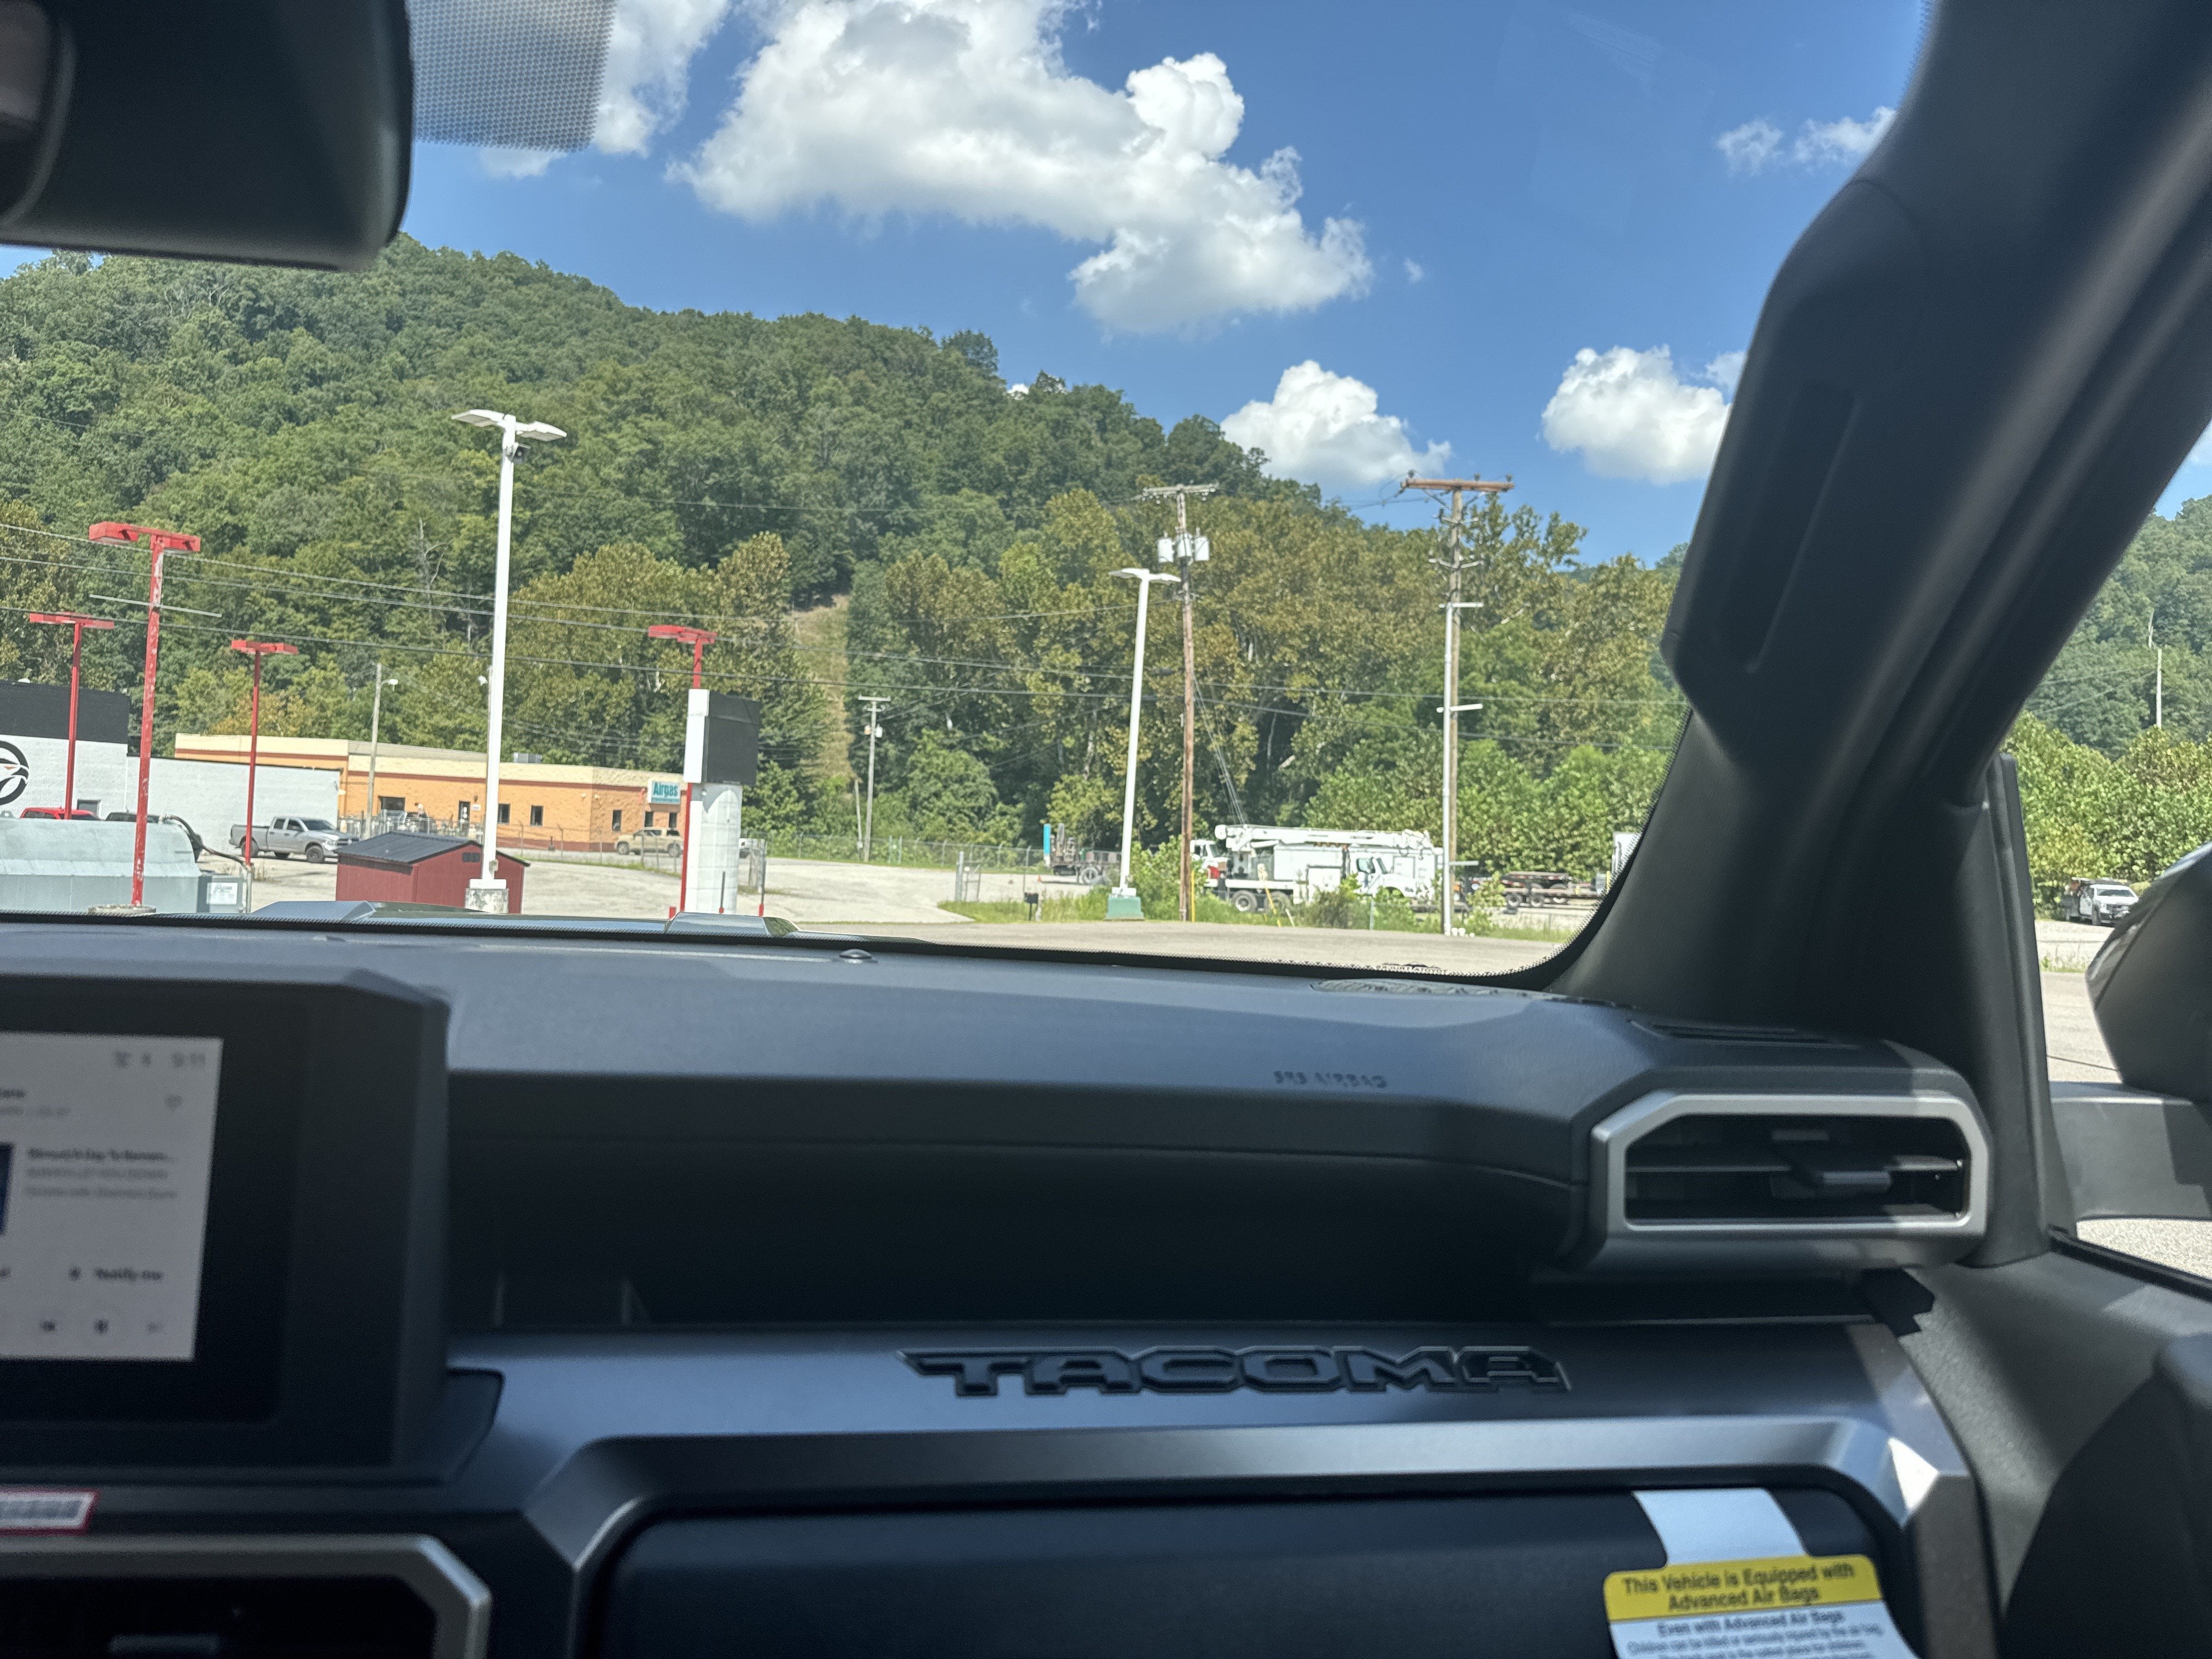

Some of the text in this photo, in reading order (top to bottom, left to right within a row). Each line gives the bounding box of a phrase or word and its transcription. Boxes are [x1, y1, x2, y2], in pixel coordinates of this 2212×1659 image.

[653, 782, 678, 798] Airgas
[895, 1346, 1571, 1397] TACOMA
[1622, 1563, 1855, 1594] This Vehicle is Equipped with
[1668, 1583, 1820, 1611] Advanced Air Bags
[1657, 1621, 1690, 1638] Even
[1694, 1620, 1722, 1634] with
[1723, 1614, 1786, 1631] Advanced
[1790, 1612, 1808, 1624] Air
